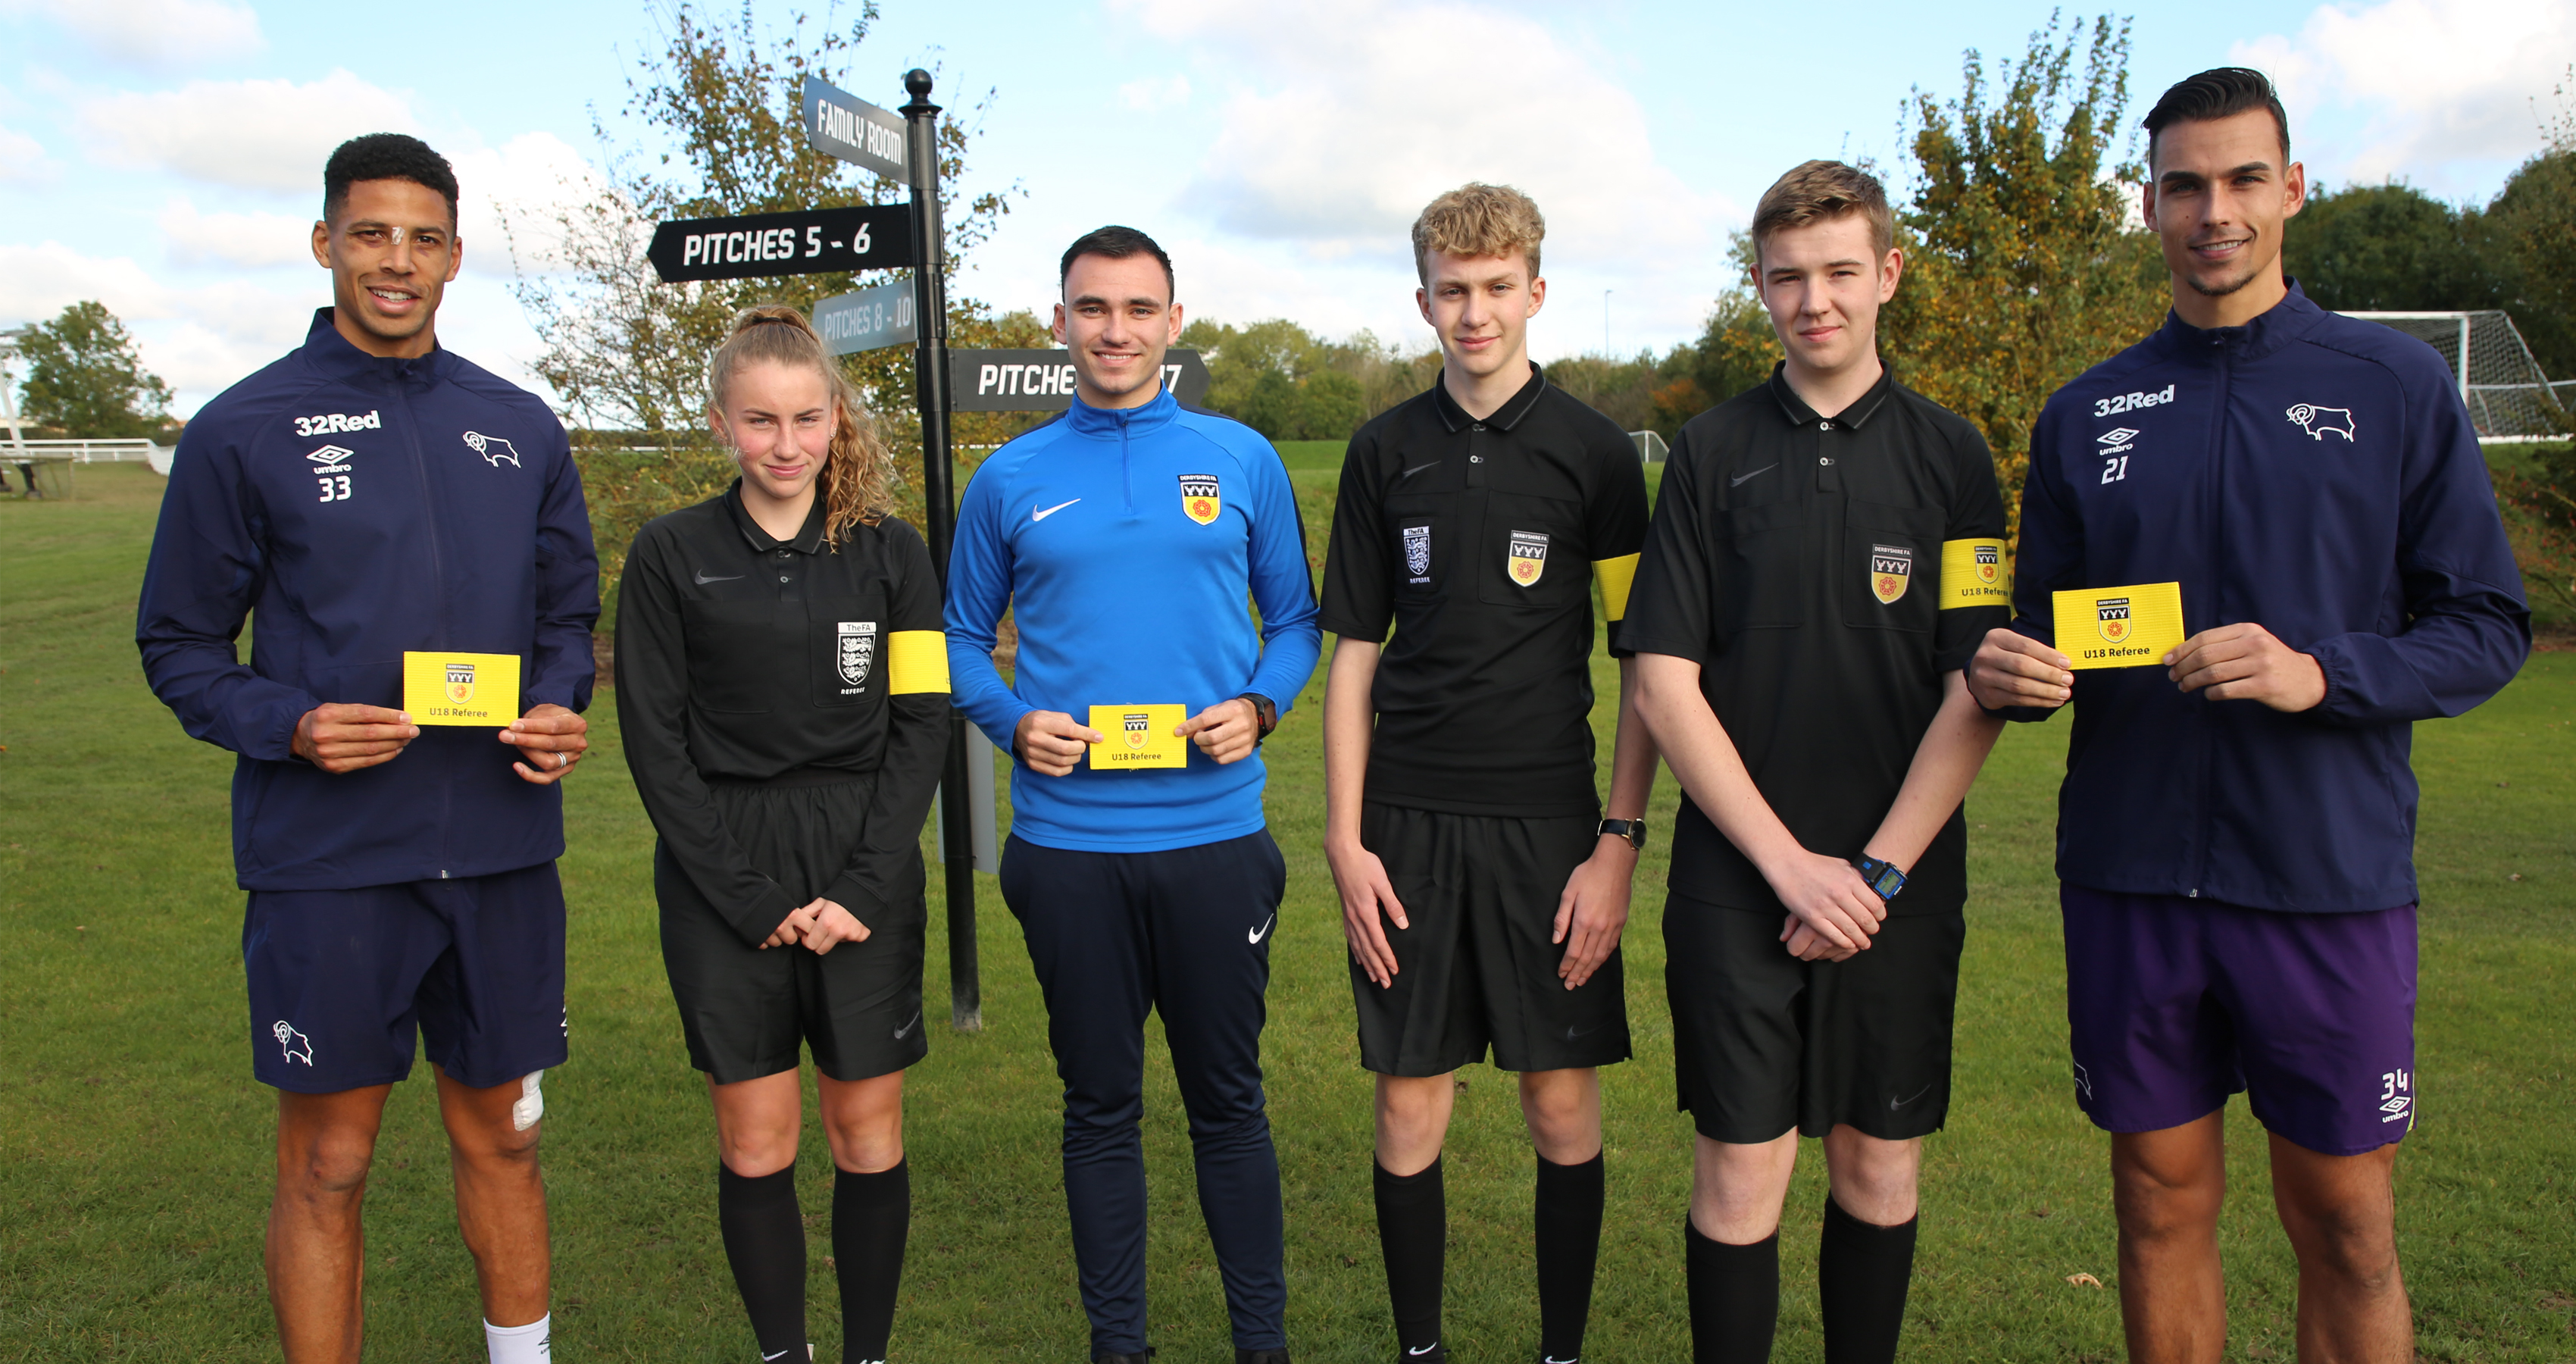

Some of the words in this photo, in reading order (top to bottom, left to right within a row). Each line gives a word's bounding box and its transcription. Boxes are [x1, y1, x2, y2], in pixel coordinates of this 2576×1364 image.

[818, 99, 864, 149] FAMILY
[867, 120, 902, 165] ROOM
[683, 228, 796, 266] PITCHES
[805, 226, 821, 258] 5
[853, 222, 871, 255] 6
[824, 305, 871, 341] PITCHES
[874, 302, 883, 332] 8
[896, 296, 911, 328] 10
[978, 364, 1077, 396] PITCHE
[2093, 384, 2174, 418] 32Red
[294, 410, 381, 436] 32Red
[2099, 443, 2134, 455] umbro
[314, 464, 352, 475] umbro
[2101, 455, 2128, 484] 21
[318, 475, 352, 503] 33
[1874, 546, 1903, 555] DERBYSHIRE
[1962, 588, 1981, 596] U18
[2084, 649, 2106, 659] U18
[2109, 647, 2150, 657] Referee
[430, 708, 449, 716] U18
[452, 708, 487, 718] Referee
[2381, 1068, 2408, 1101] 34
[2382, 1109, 2409, 1123] umbro
